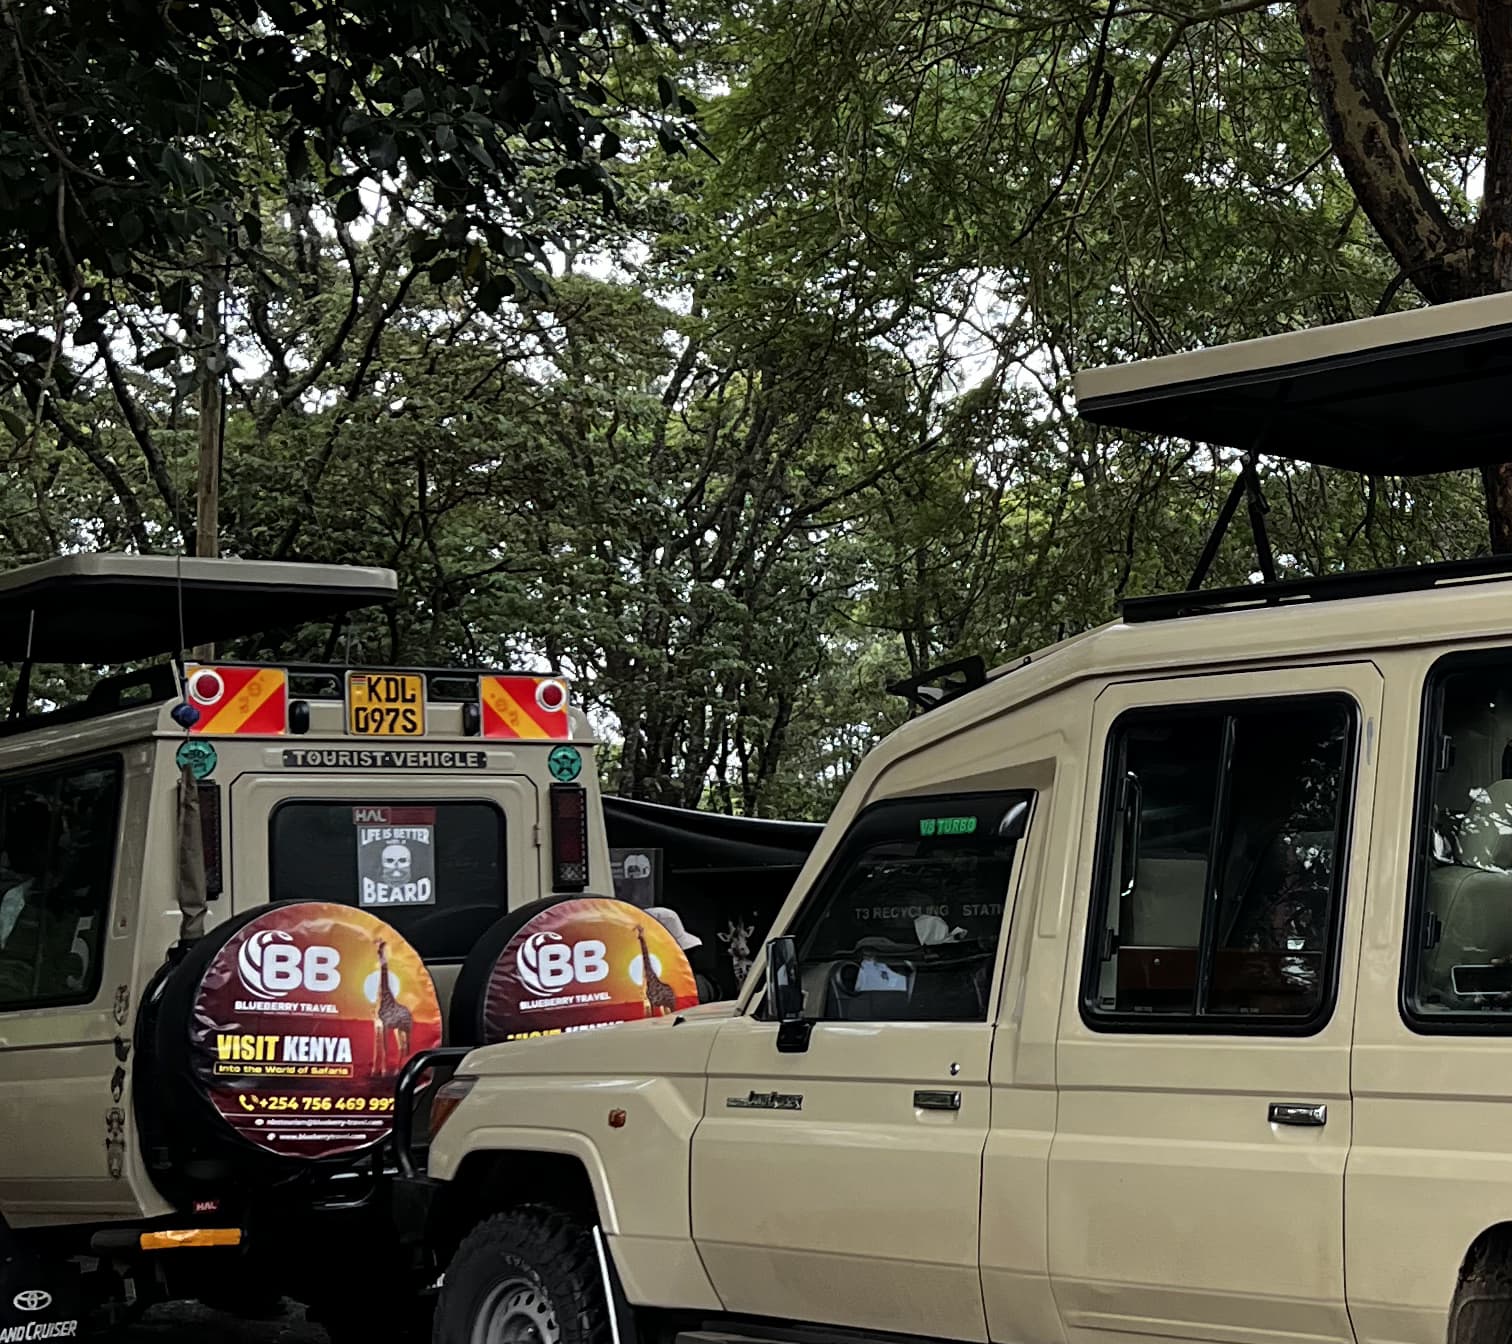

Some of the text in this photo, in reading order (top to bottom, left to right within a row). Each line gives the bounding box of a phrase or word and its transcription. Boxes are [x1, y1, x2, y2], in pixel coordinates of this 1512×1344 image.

[366, 677, 417, 703] KDL
[355, 707, 417, 734] 097S
[293, 751, 478, 768] TOURIST VEHICLE
[355, 809, 387, 822] HAL
[920, 816, 977, 836] V8 TURBO
[361, 828, 430, 846] LIFE IS BETTER
[363, 876, 431, 903] BEARD
[855, 908, 870, 920] T3
[873, 905, 949, 919] RECYCLING
[234, 1000, 339, 1014] BLUEBERRY TRAVEL
[519, 992, 611, 1010] BLUEBERRY TRAVEL
[217, 1034, 352, 1062] VISIT KENYA
[219, 1065, 349, 1075] Into the World of Safaris
[260, 1096, 299, 1110] +254
[302, 1097, 332, 1110] 756
[335, 1097, 366, 1111] 469
[0, 1320, 78, 1344] ANDCRUISER
